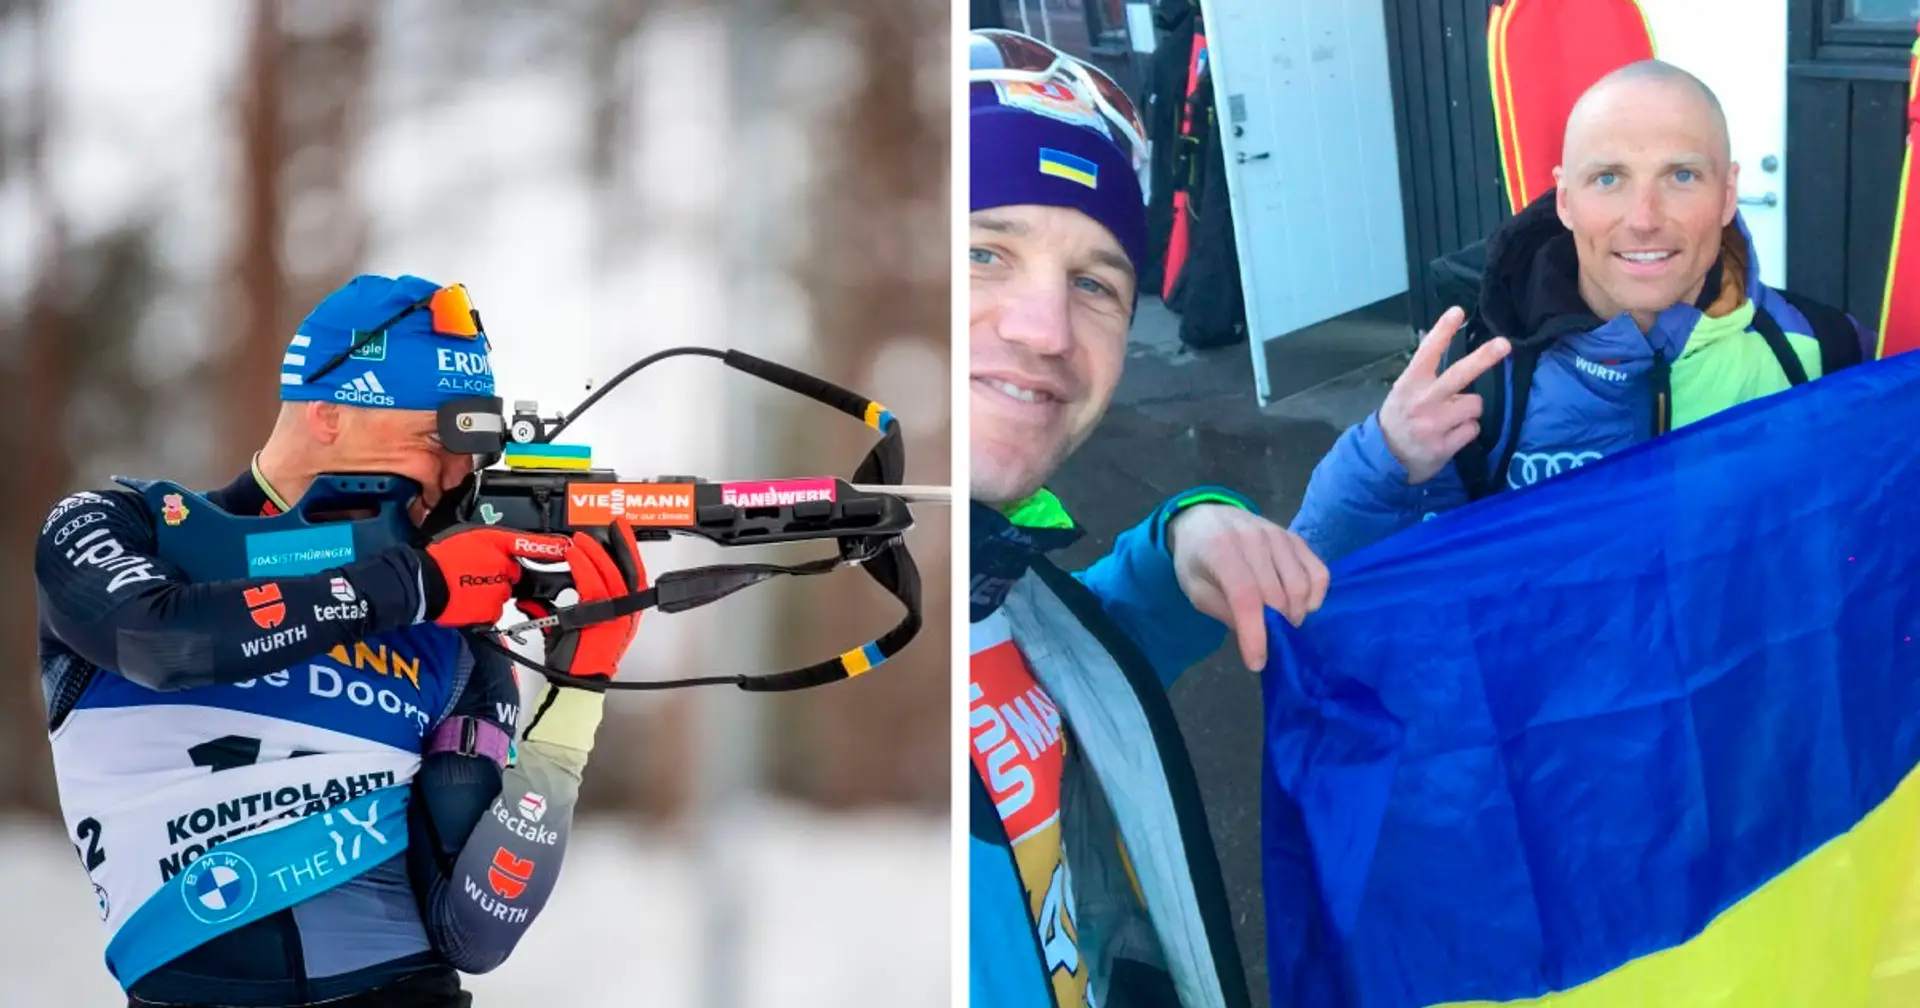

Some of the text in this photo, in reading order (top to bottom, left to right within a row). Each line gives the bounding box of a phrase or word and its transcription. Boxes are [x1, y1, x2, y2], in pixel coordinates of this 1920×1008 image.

[334, 389, 395, 406] adidas
[572, 488, 690, 516] VIESSMANN
[66, 528, 166, 593] Audi
[309, 664, 429, 737] Doors
[167, 770, 394, 845] KONTIOLAHTI
[492, 799, 558, 845] tectake
[186, 856, 239, 886] BMW
[268, 851, 334, 893] THE
